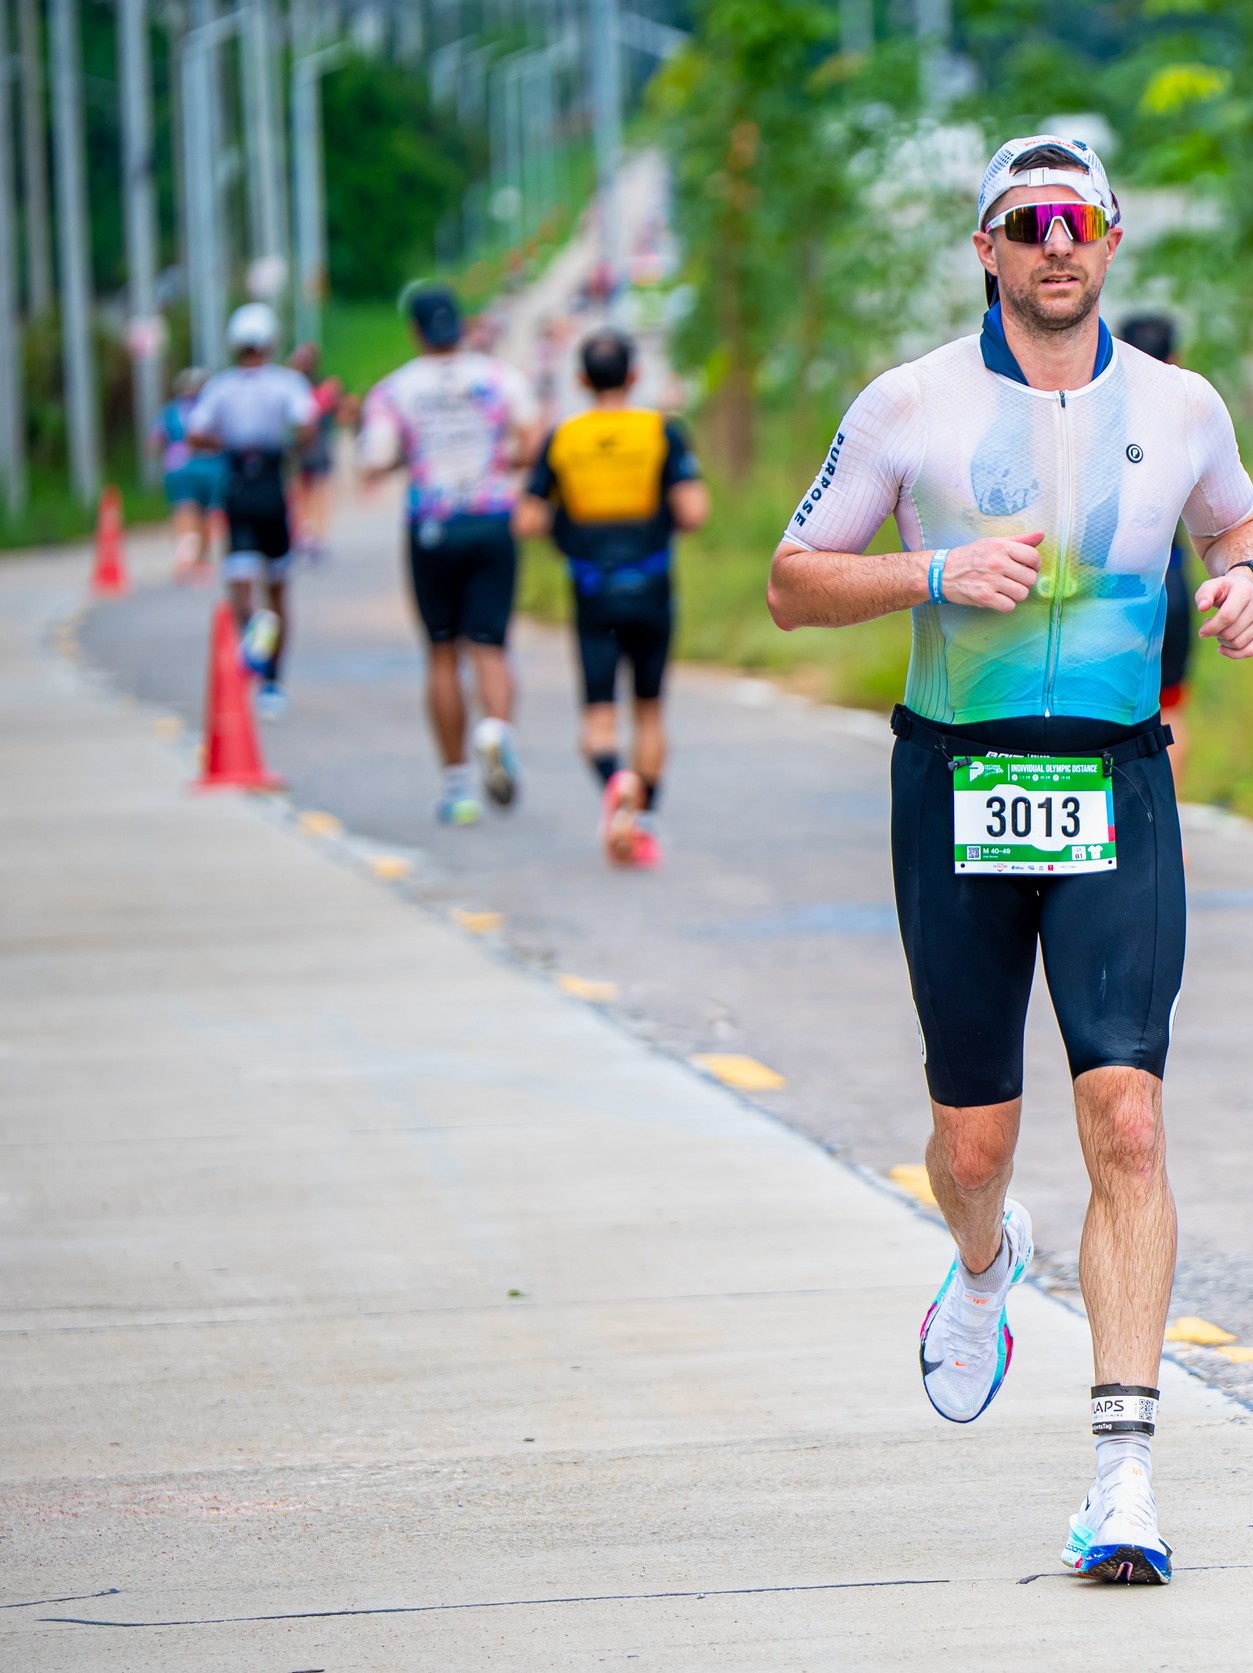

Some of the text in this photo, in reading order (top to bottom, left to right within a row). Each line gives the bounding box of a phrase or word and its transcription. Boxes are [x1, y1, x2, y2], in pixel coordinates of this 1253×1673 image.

[794, 432, 845, 527] PURPOSE
[1010, 763, 1045, 773] INDIVIDUAL
[1045, 764, 1071, 773] OLYMPIC
[1072, 764, 1098, 773] DISTANCE
[986, 796, 1081, 838] 3013
[982, 847, 990, 855] M
